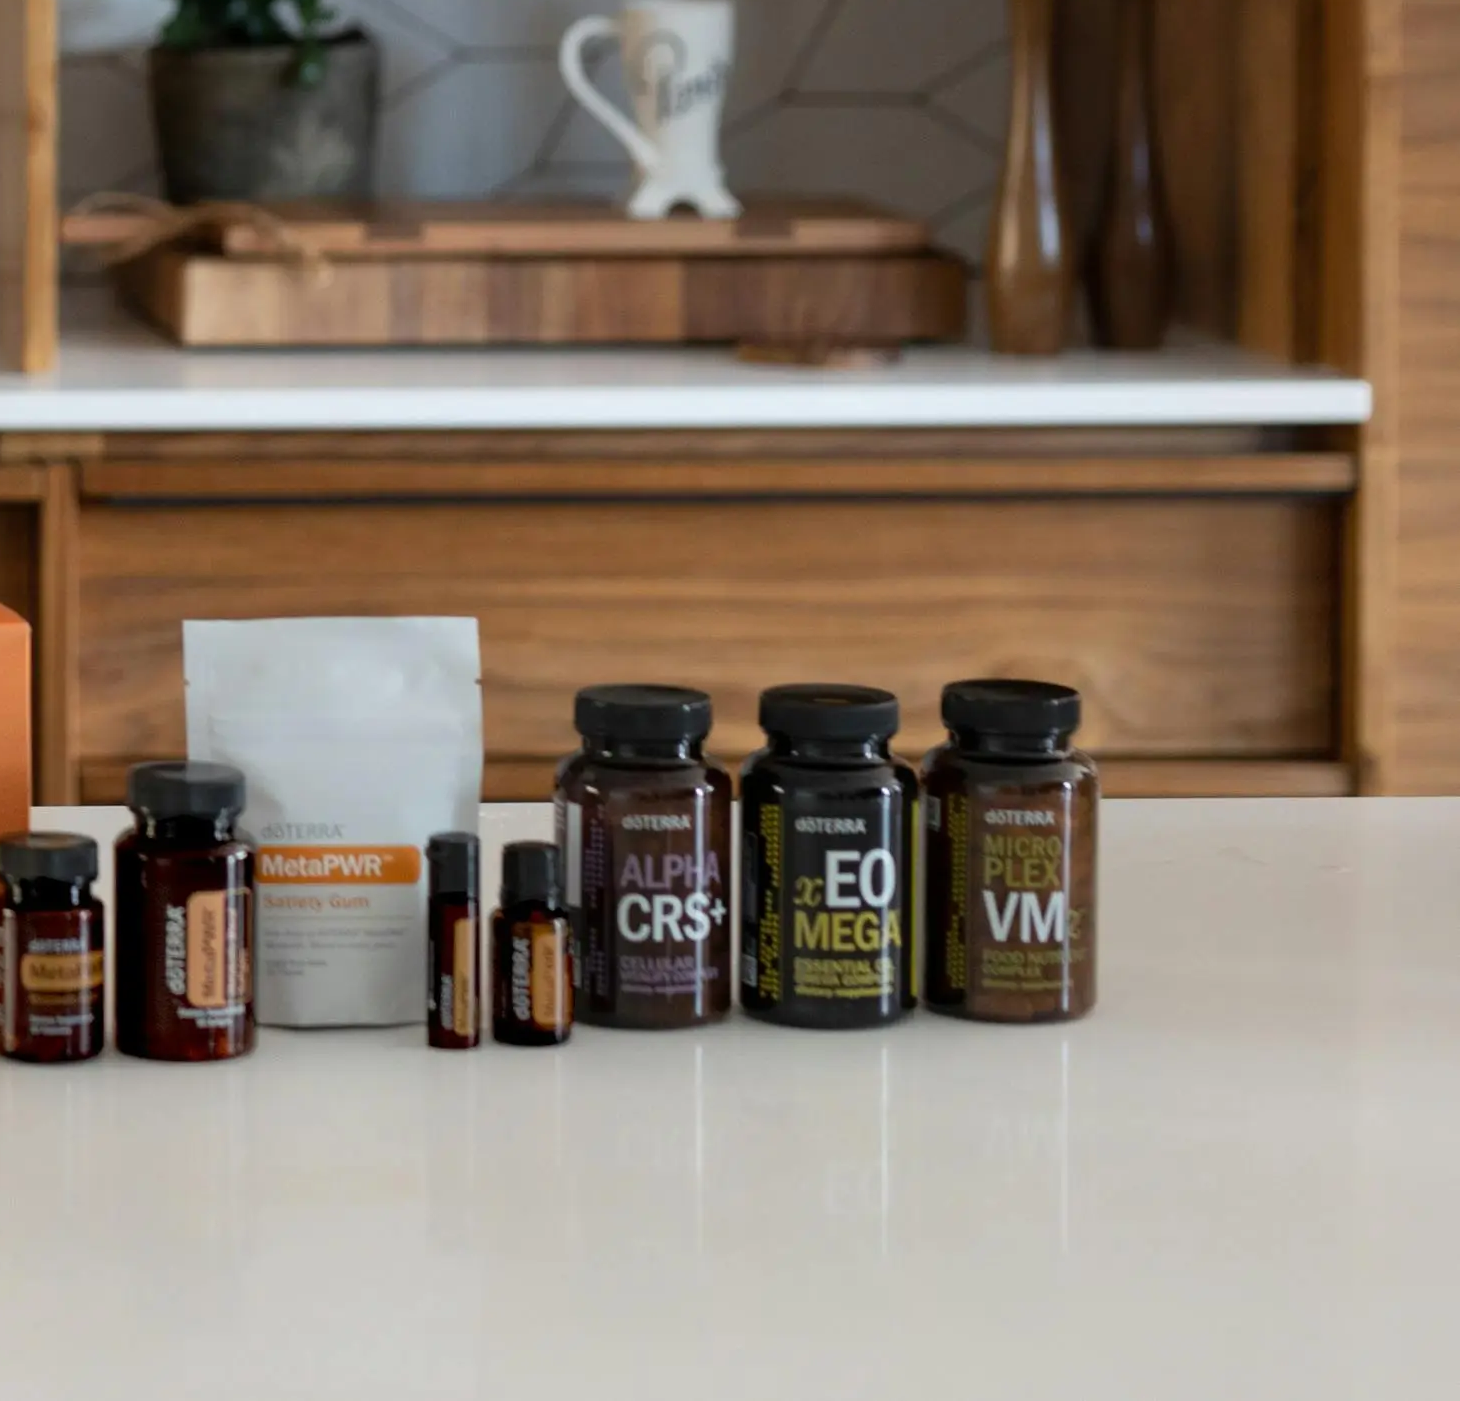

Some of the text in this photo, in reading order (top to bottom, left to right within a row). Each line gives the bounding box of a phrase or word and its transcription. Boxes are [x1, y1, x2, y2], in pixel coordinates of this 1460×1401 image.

[983, 833, 1062, 858] MICRO
[620, 851, 721, 889] ALPHA
[983, 855, 1060, 888] PLEX
[617, 892, 727, 943] CRS+
[793, 909, 901, 951] MEGA
